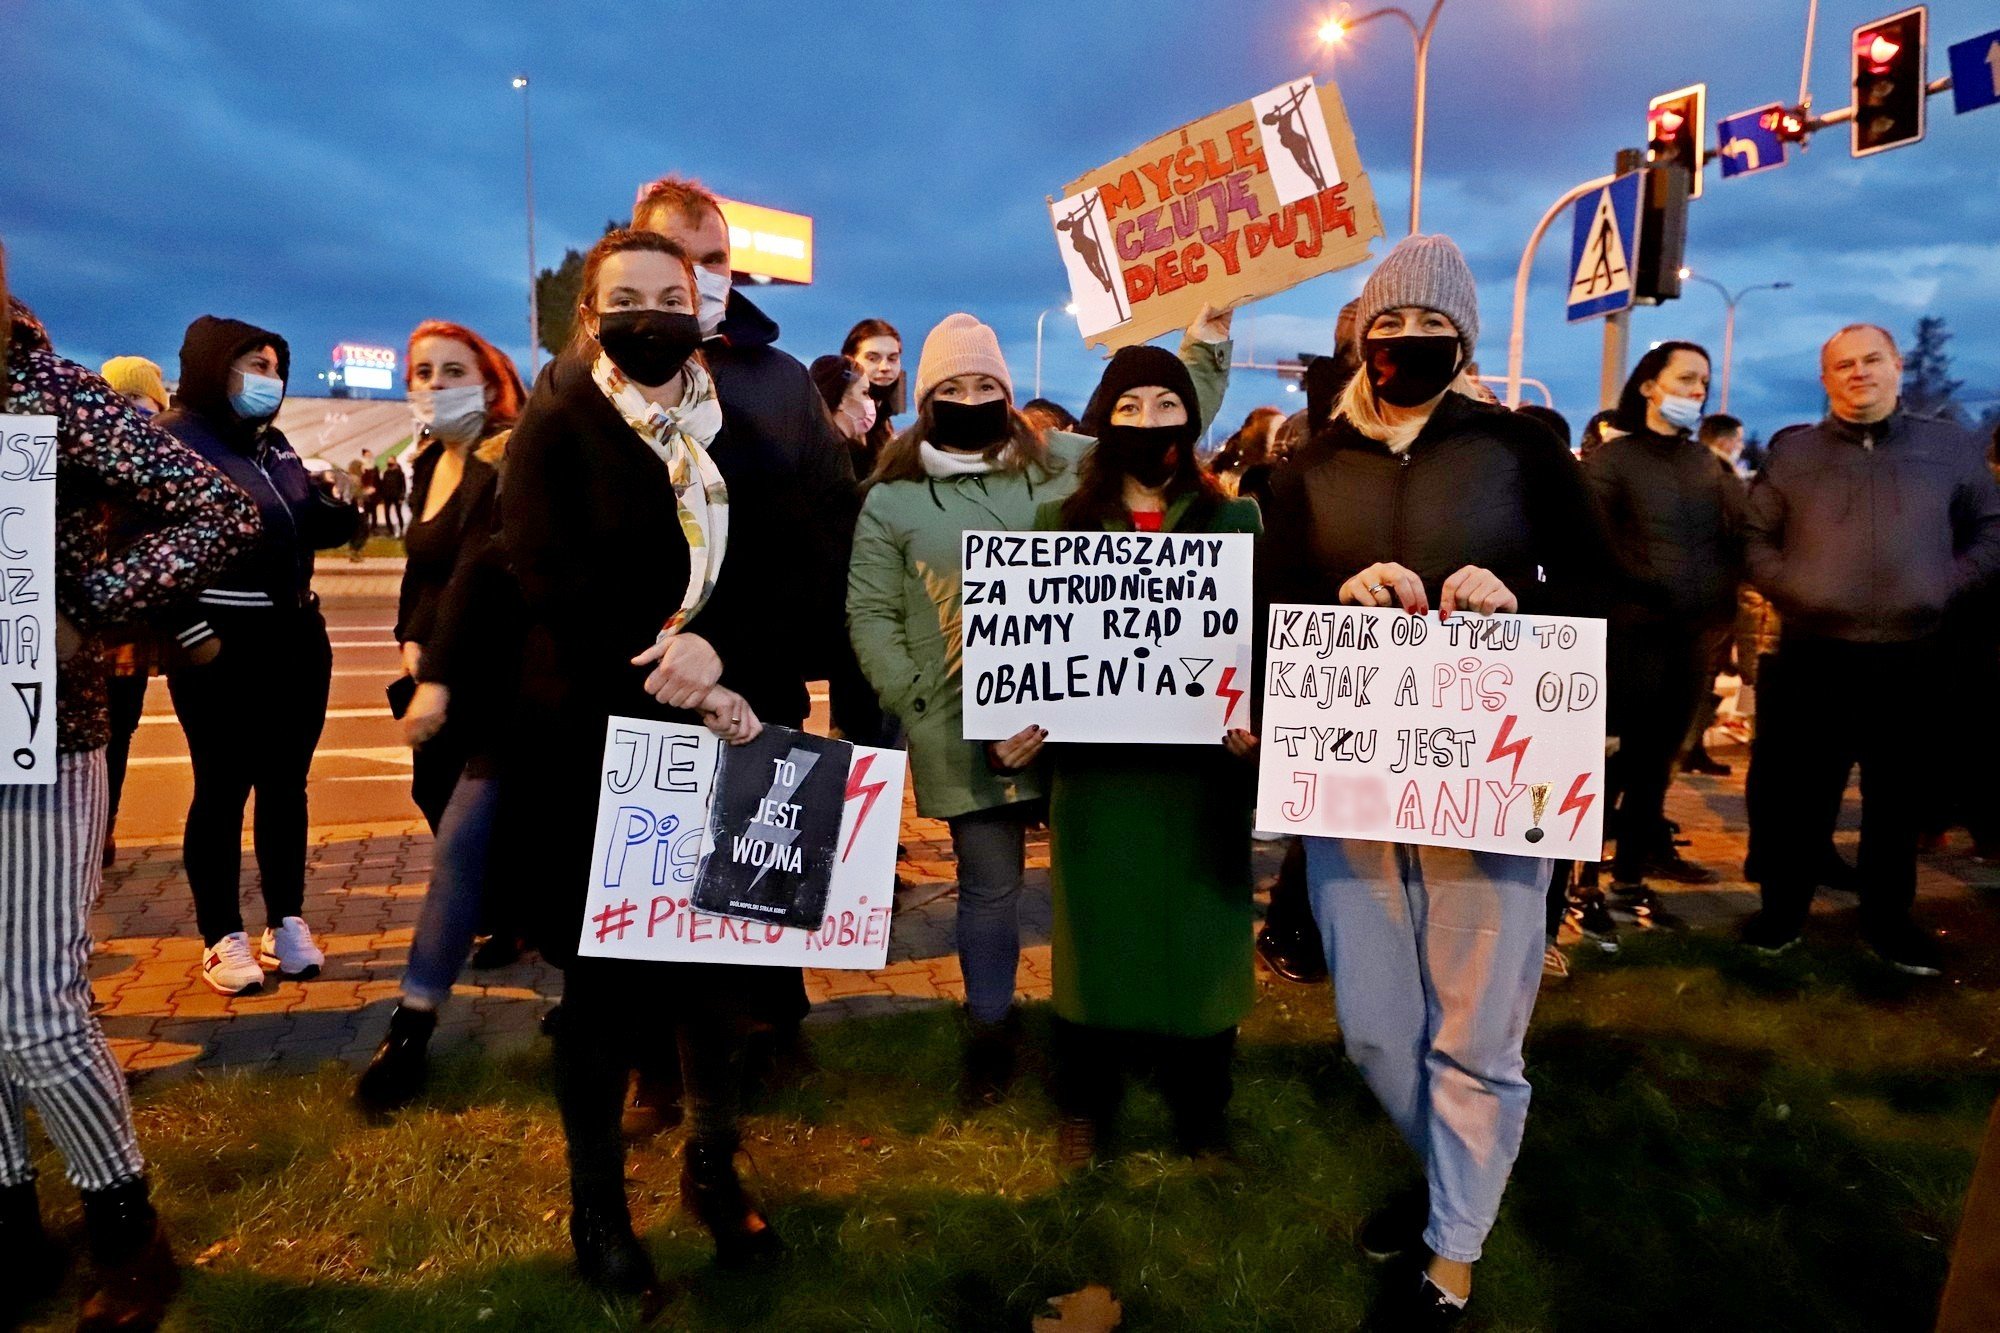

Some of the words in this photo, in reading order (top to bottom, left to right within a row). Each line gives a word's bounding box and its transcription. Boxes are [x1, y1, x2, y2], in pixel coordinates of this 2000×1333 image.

[1098, 120, 1268, 221] MYŚLĘ
[1115, 171, 1262, 261] CZUJĘ
[1122, 181, 1357, 304] DECYDUJĘ
[343, 345, 396, 363] TESCO
[0, 432, 56, 482] SZ
[965, 534, 1223, 571] PRZEPRASZAMY
[963, 579, 1006, 605] ZA
[966, 612, 1074, 647] MAMY
[1103, 607, 1181, 647] RZĄD
[1203, 607, 1239, 638] DO
[1269, 609, 1380, 660] KAJAK
[1391, 615, 1428, 647] OD
[1440, 615, 1522, 651] TYŁU
[1533, 623, 1578, 650] TO
[1269, 661, 1380, 710] KAJAK
[1394, 666, 1419, 707] A
[1536, 671, 1598, 713] OD
[607, 728, 723, 808] JE
[773, 758, 796, 787] TO
[1274, 726, 1378, 763] TYŁU
[1390, 728, 1476, 773] JEST
[750, 797, 802, 830] JEST
[1281, 771, 1554, 844] JANY!
[732, 835, 802, 874] WOJNA
